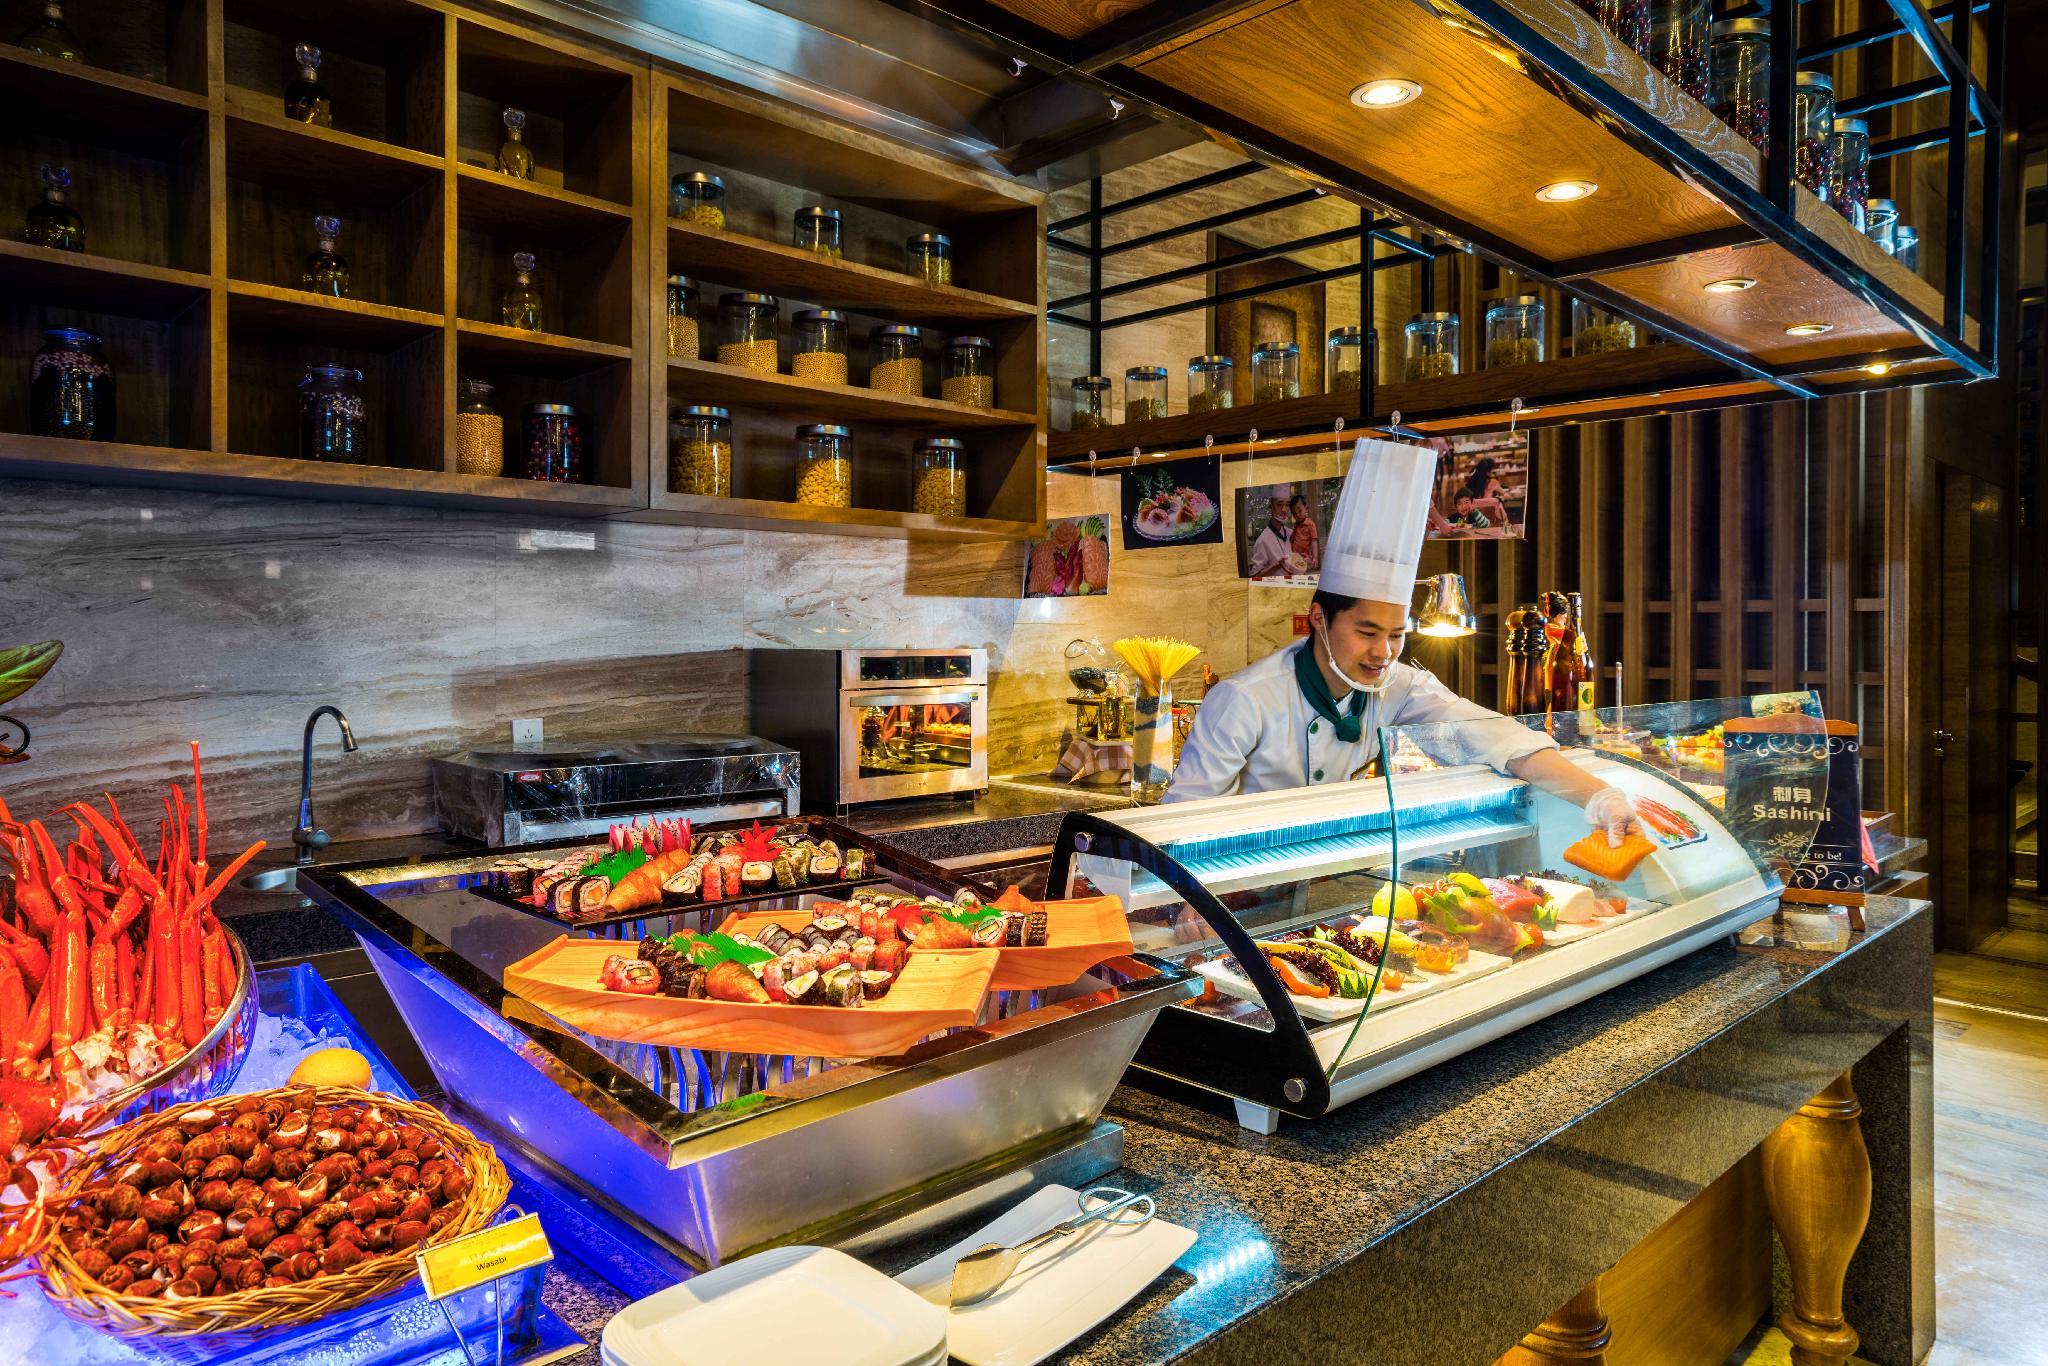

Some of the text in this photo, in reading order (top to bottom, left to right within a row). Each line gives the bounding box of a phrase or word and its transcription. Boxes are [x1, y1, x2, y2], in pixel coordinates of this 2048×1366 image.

[1773, 786, 1812, 803] 刺身
[1753, 804, 1831, 821] Sashimi
[1814, 851, 1825, 859] to
[476, 1256, 507, 1270] Wasabi
